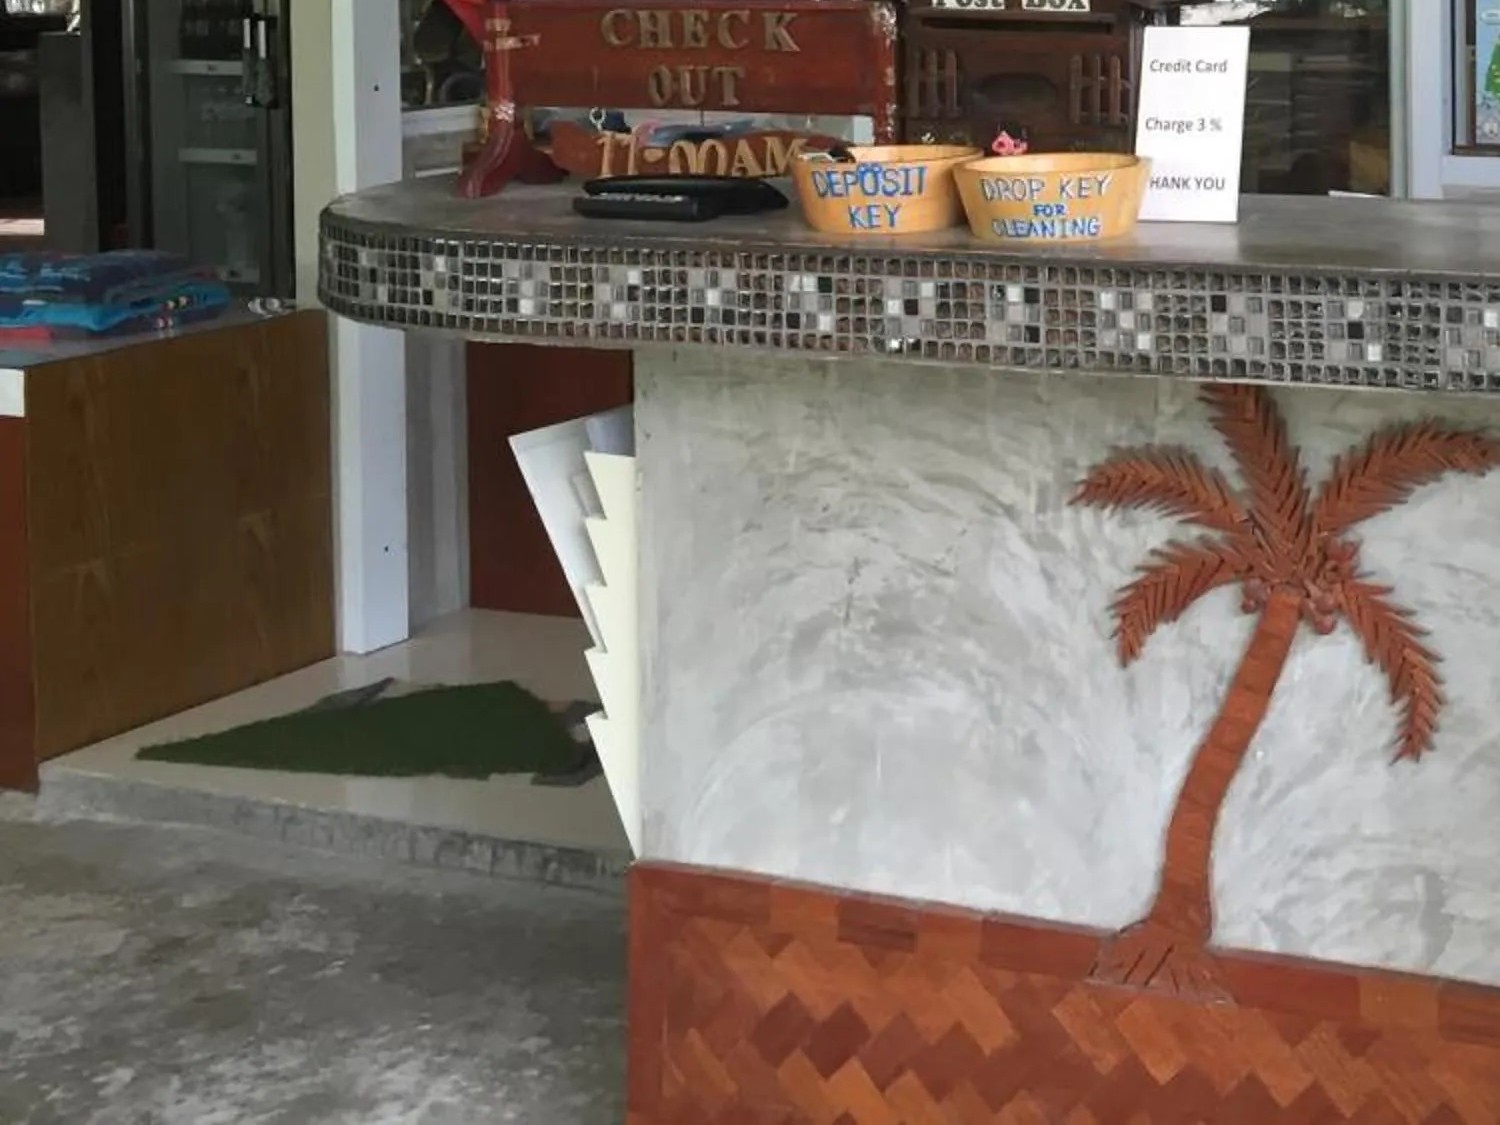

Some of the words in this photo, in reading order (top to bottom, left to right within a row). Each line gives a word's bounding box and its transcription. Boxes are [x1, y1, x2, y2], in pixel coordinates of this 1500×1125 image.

[602, 8, 801, 53] CHECK
[1149, 59, 1192, 73] Credit
[1195, 59, 1228, 73] Card
[648, 65, 746, 108] OUT
[1145, 117, 1193, 134] Charge
[1198, 118, 1206, 131] 3
[1209, 117, 1223, 132] %
[812, 163, 928, 197] DEPOSIT
[980, 177, 1045, 202] DROP
[1059, 174, 1113, 199] KEY
[1149, 176, 1192, 190] HANK
[1195, 177, 1226, 190] YOU
[848, 203, 901, 230] KEY
[1033, 204, 1066, 216] FOR
[992, 217, 1101, 238] CLEANING
